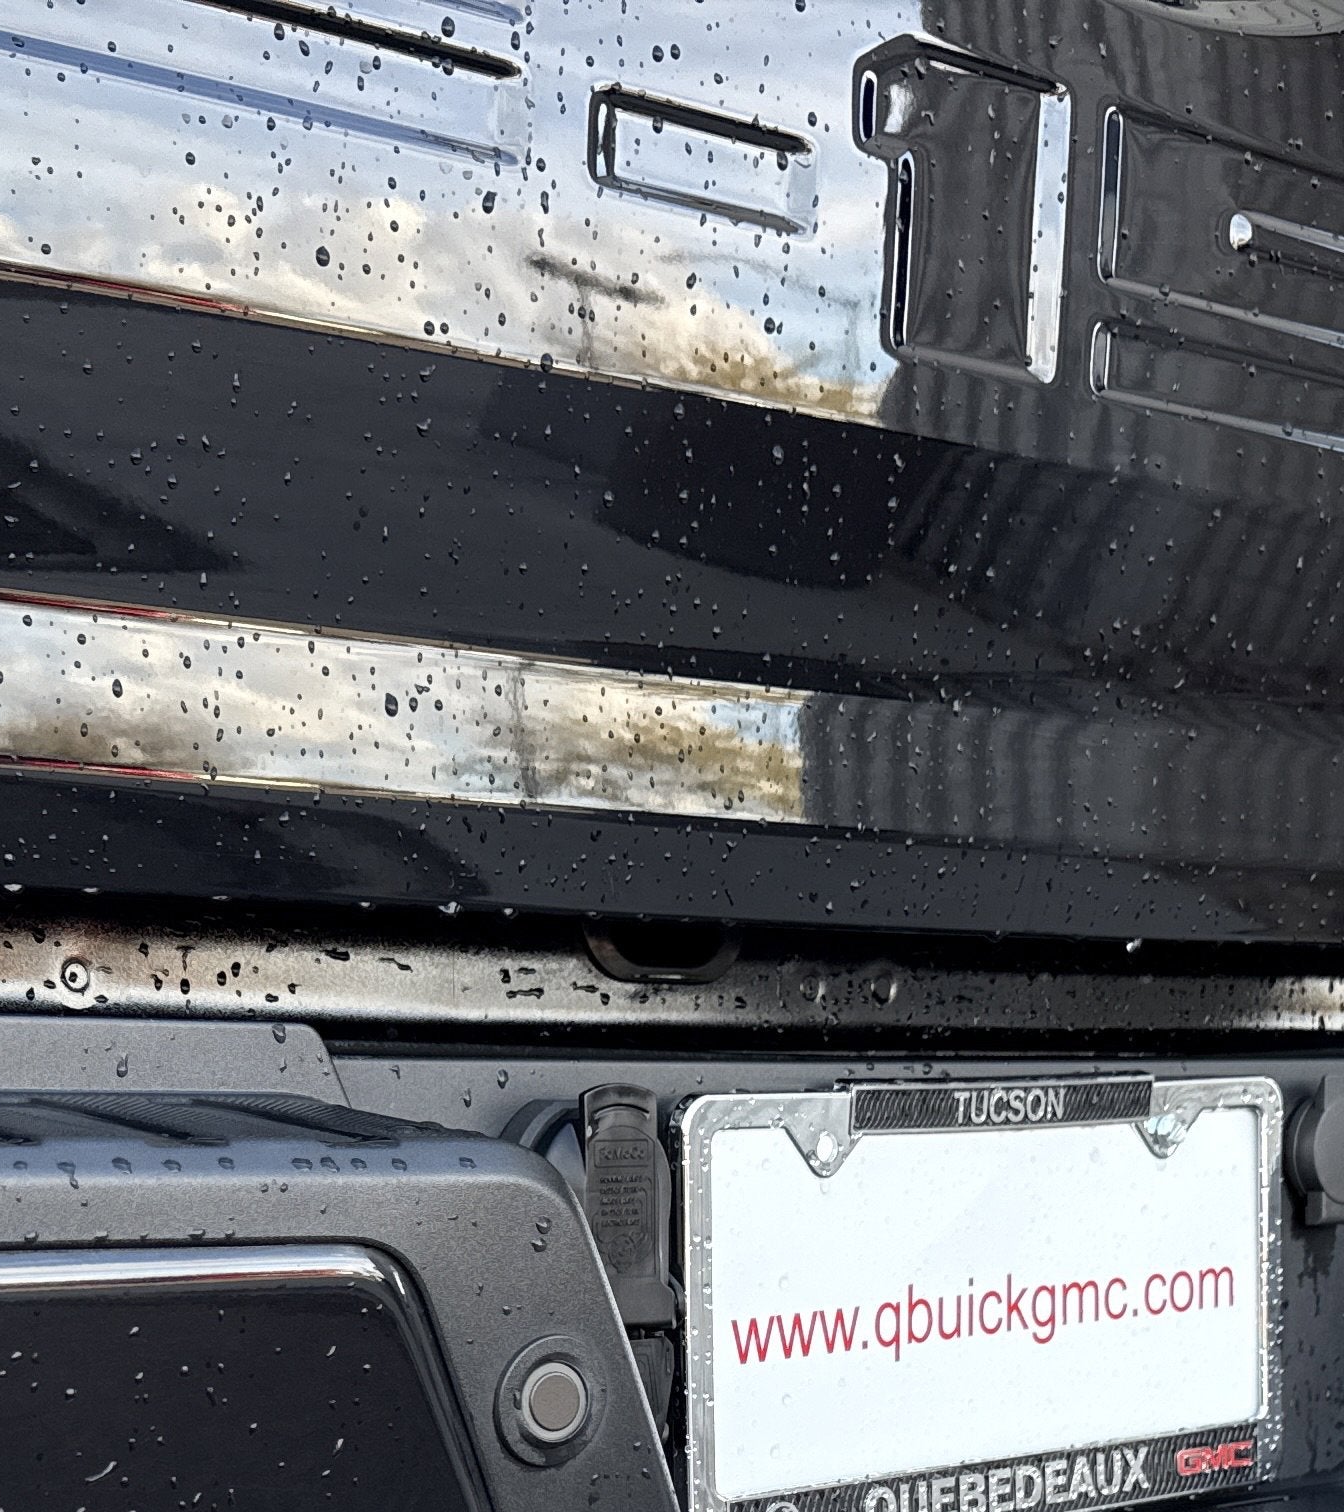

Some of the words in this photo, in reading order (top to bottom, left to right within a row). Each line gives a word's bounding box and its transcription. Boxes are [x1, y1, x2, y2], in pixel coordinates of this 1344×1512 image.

[952, 1086, 1066, 1126] TUCSON
[730, 1265, 1235, 1365] www.qbuickgmc.com
[1175, 1440, 1255, 1478] GMC
